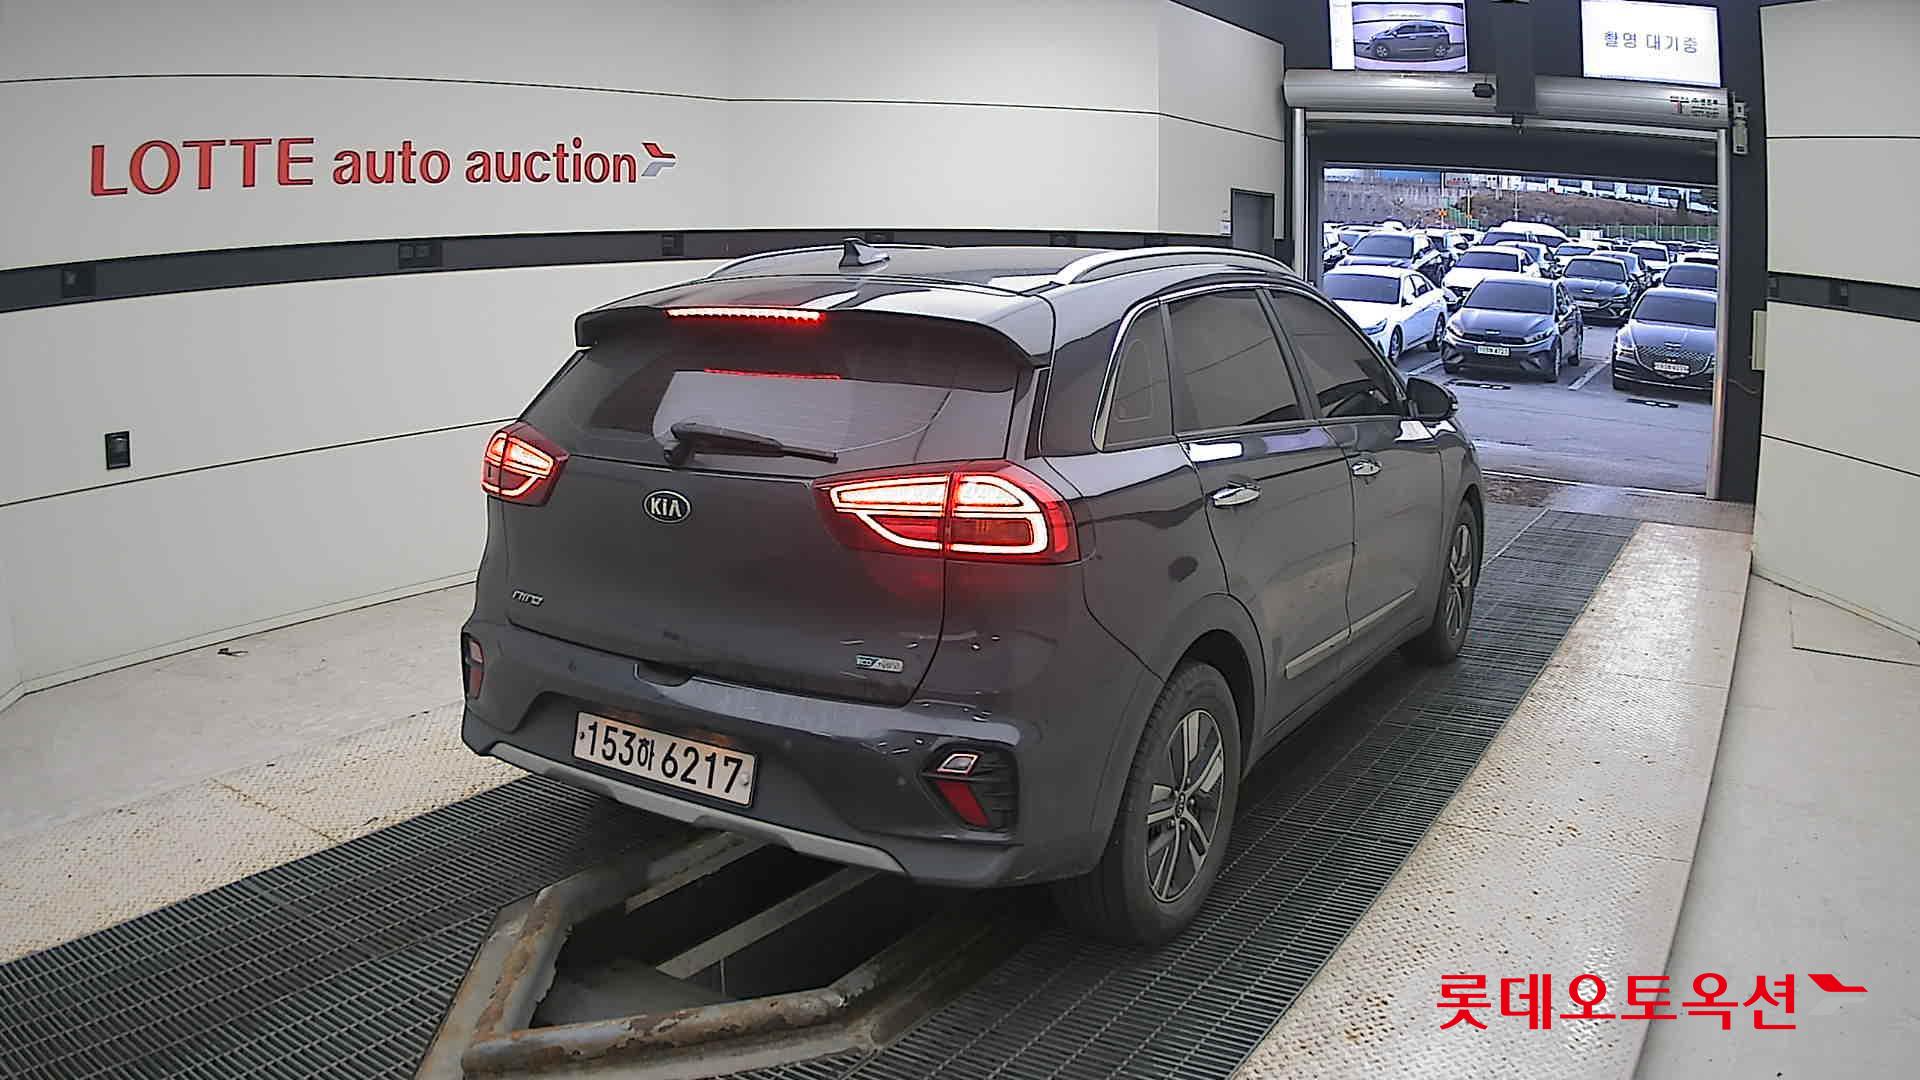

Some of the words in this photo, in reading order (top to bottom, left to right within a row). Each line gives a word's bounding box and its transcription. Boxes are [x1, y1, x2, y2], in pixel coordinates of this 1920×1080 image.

[1646, 33, 1698, 54] 대기중
[90, 137, 314, 197] LOTTE
[333, 141, 450, 185] auto
[466, 136, 637, 183] auction
[650, 497, 682, 518] KIA
[587, 721, 656, 771] 153하
[660, 742, 744, 794] 6217
